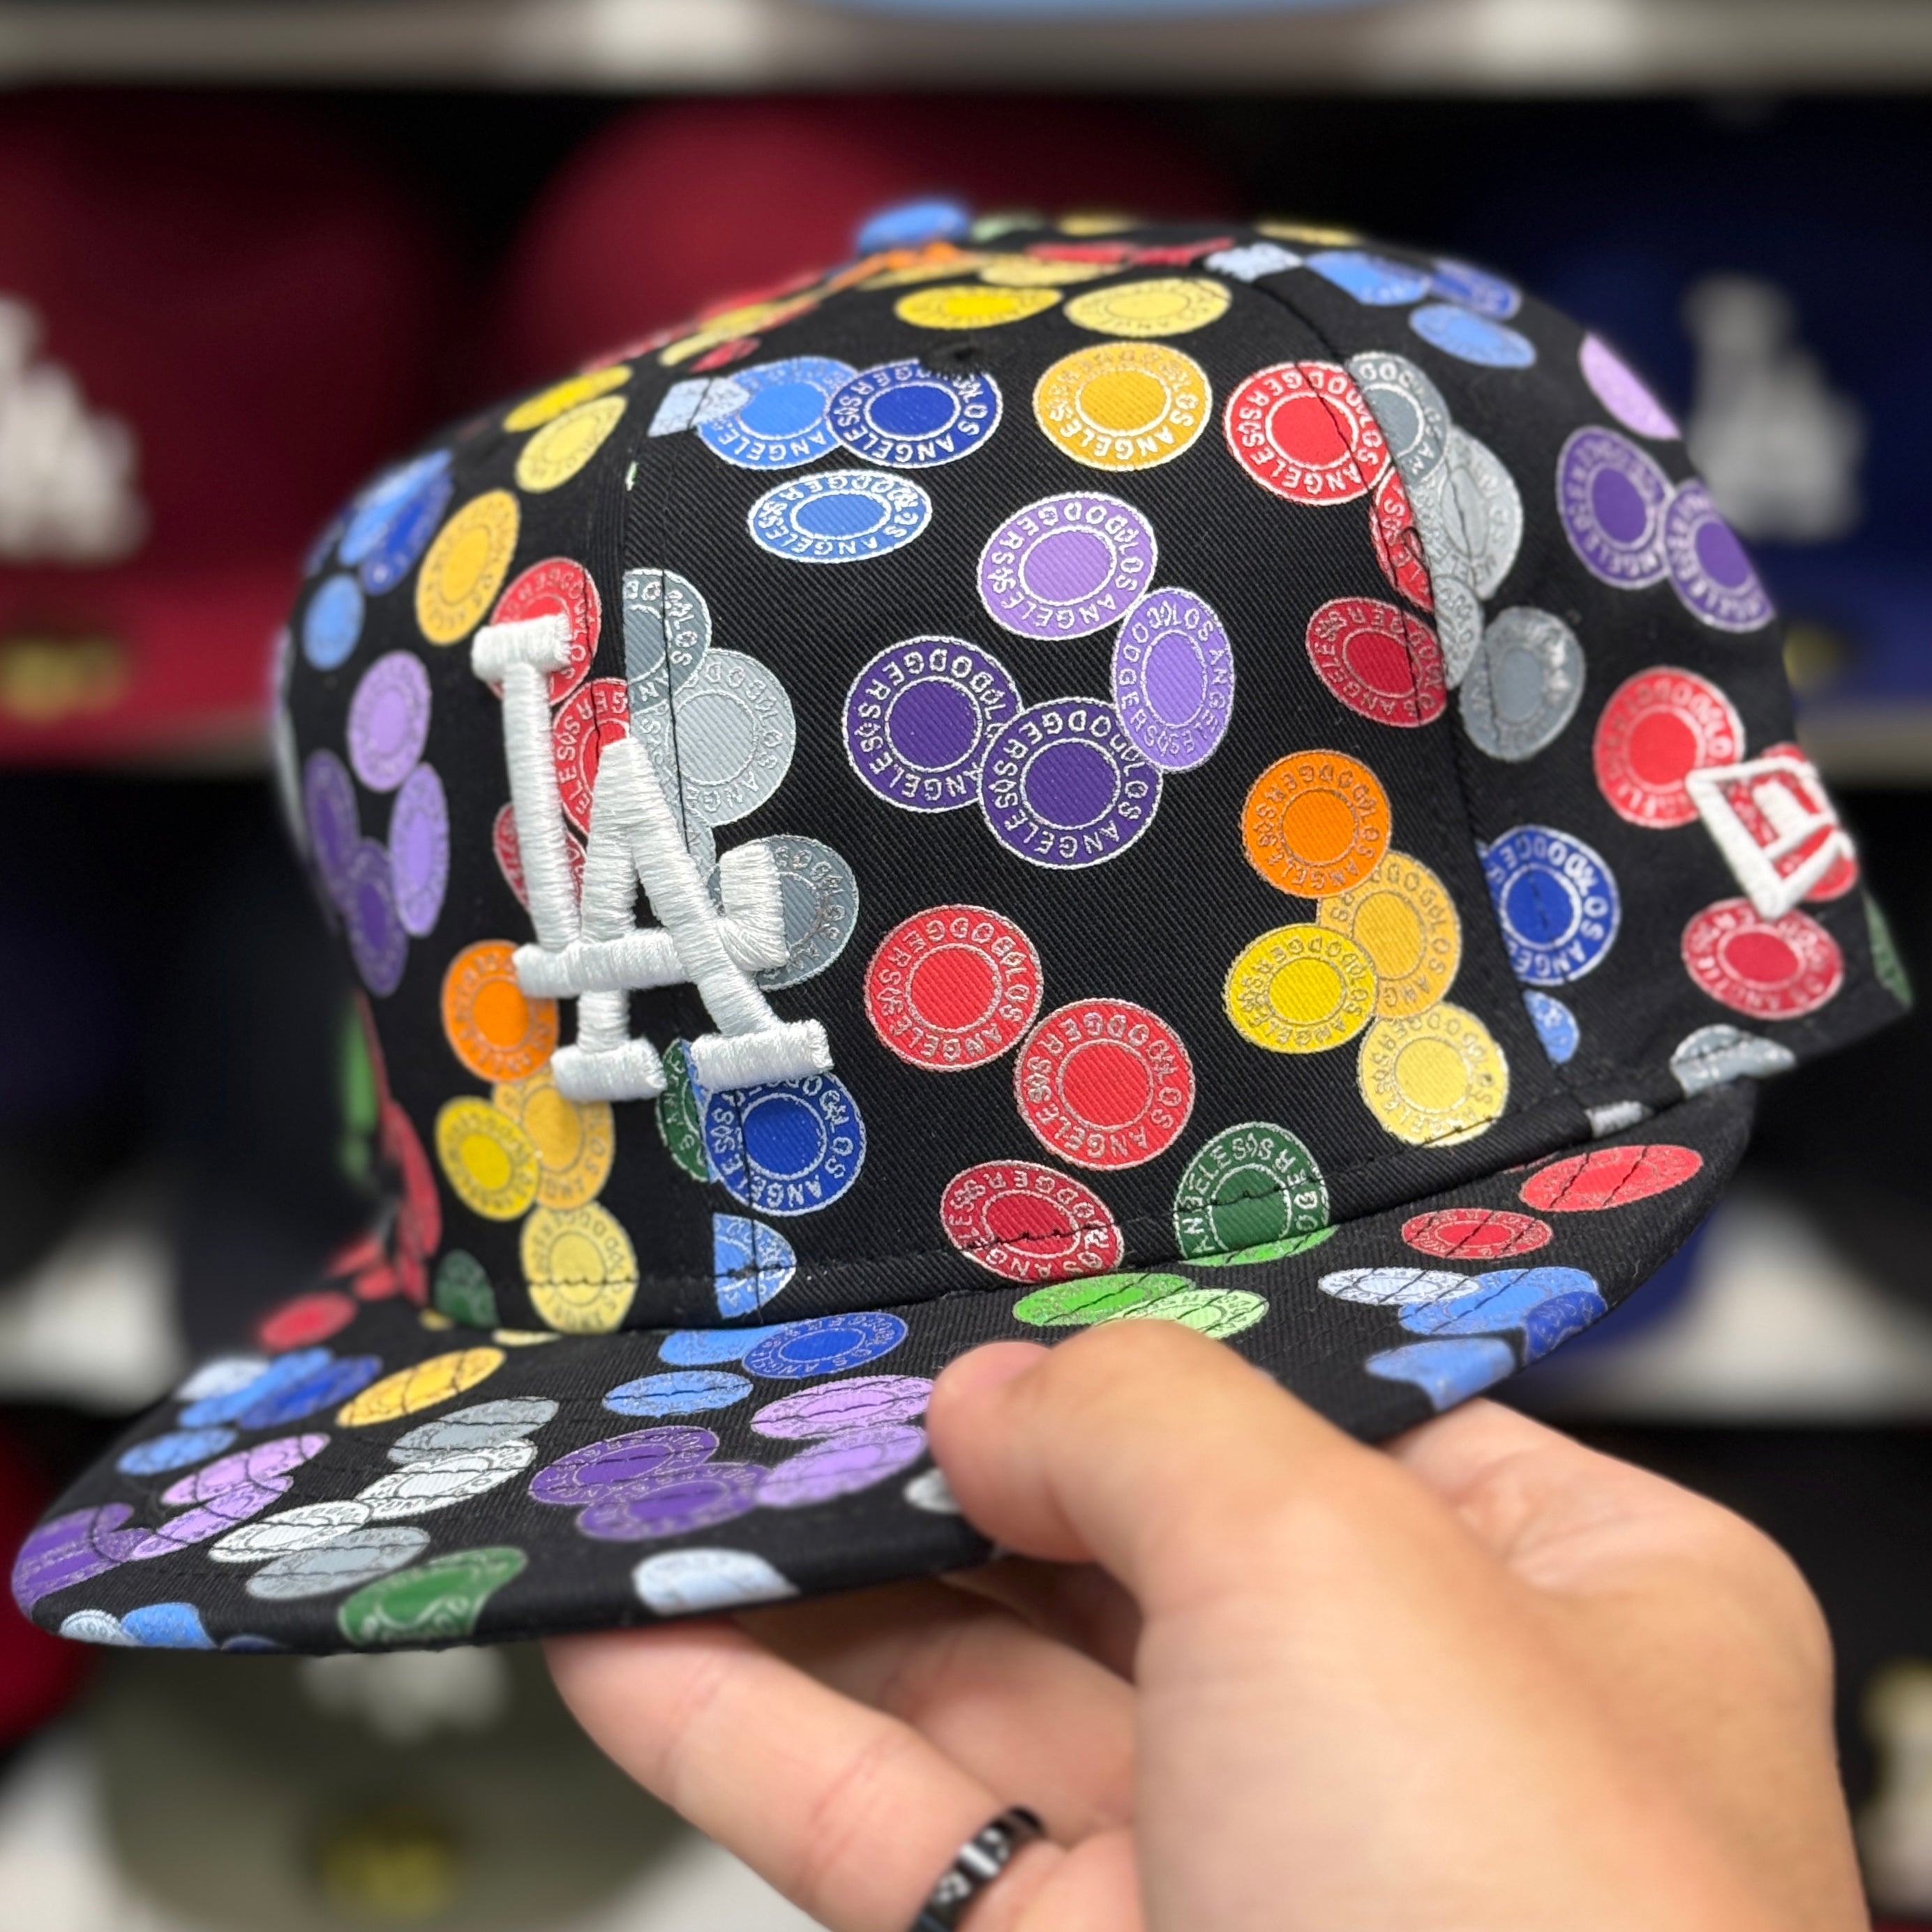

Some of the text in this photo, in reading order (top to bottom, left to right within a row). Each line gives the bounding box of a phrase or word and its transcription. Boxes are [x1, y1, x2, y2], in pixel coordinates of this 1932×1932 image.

[838, 390, 987, 462] LOS ANGELES
[1049, 404, 1174, 460] ANGELES
[1242, 433, 1361, 494] ANGELES
[991, 502, 1128, 564] DODGERS
[992, 542, 1144, 629] LOS ANGELES
[670, 615, 698, 666] LOS
[1173, 604, 1213, 641] LOS
[858, 648, 994, 719] DODGERS
[1119, 607, 1162, 746] DODGERS
[564, 691, 627, 733] GERS
[757, 710, 783, 769] LOS
[994, 710, 1127, 776] DODGERS
[558, 747, 591, 815] ELES
[860, 735, 982, 801] ANGELES
[1256, 763, 1370, 818] DODGERS
[994, 761, 1148, 858] LOS ANGELES
[1357, 808, 1379, 859] LOS
[471, 613, 834, 1102] LA
[1578, 878, 1608, 940] LOS
[878, 918, 1016, 984] DODGERS
[1428, 919, 1451, 975] LOS
[881, 968, 1030, 1061] LOS ANGELES
[1027, 1012, 1169, 1074] DODGERS
[1027, 1066, 1182, 1158] LOS ANGELES
[824, 1116, 853, 1178] LOS
[1178, 1138, 1247, 1253] ANGELES
